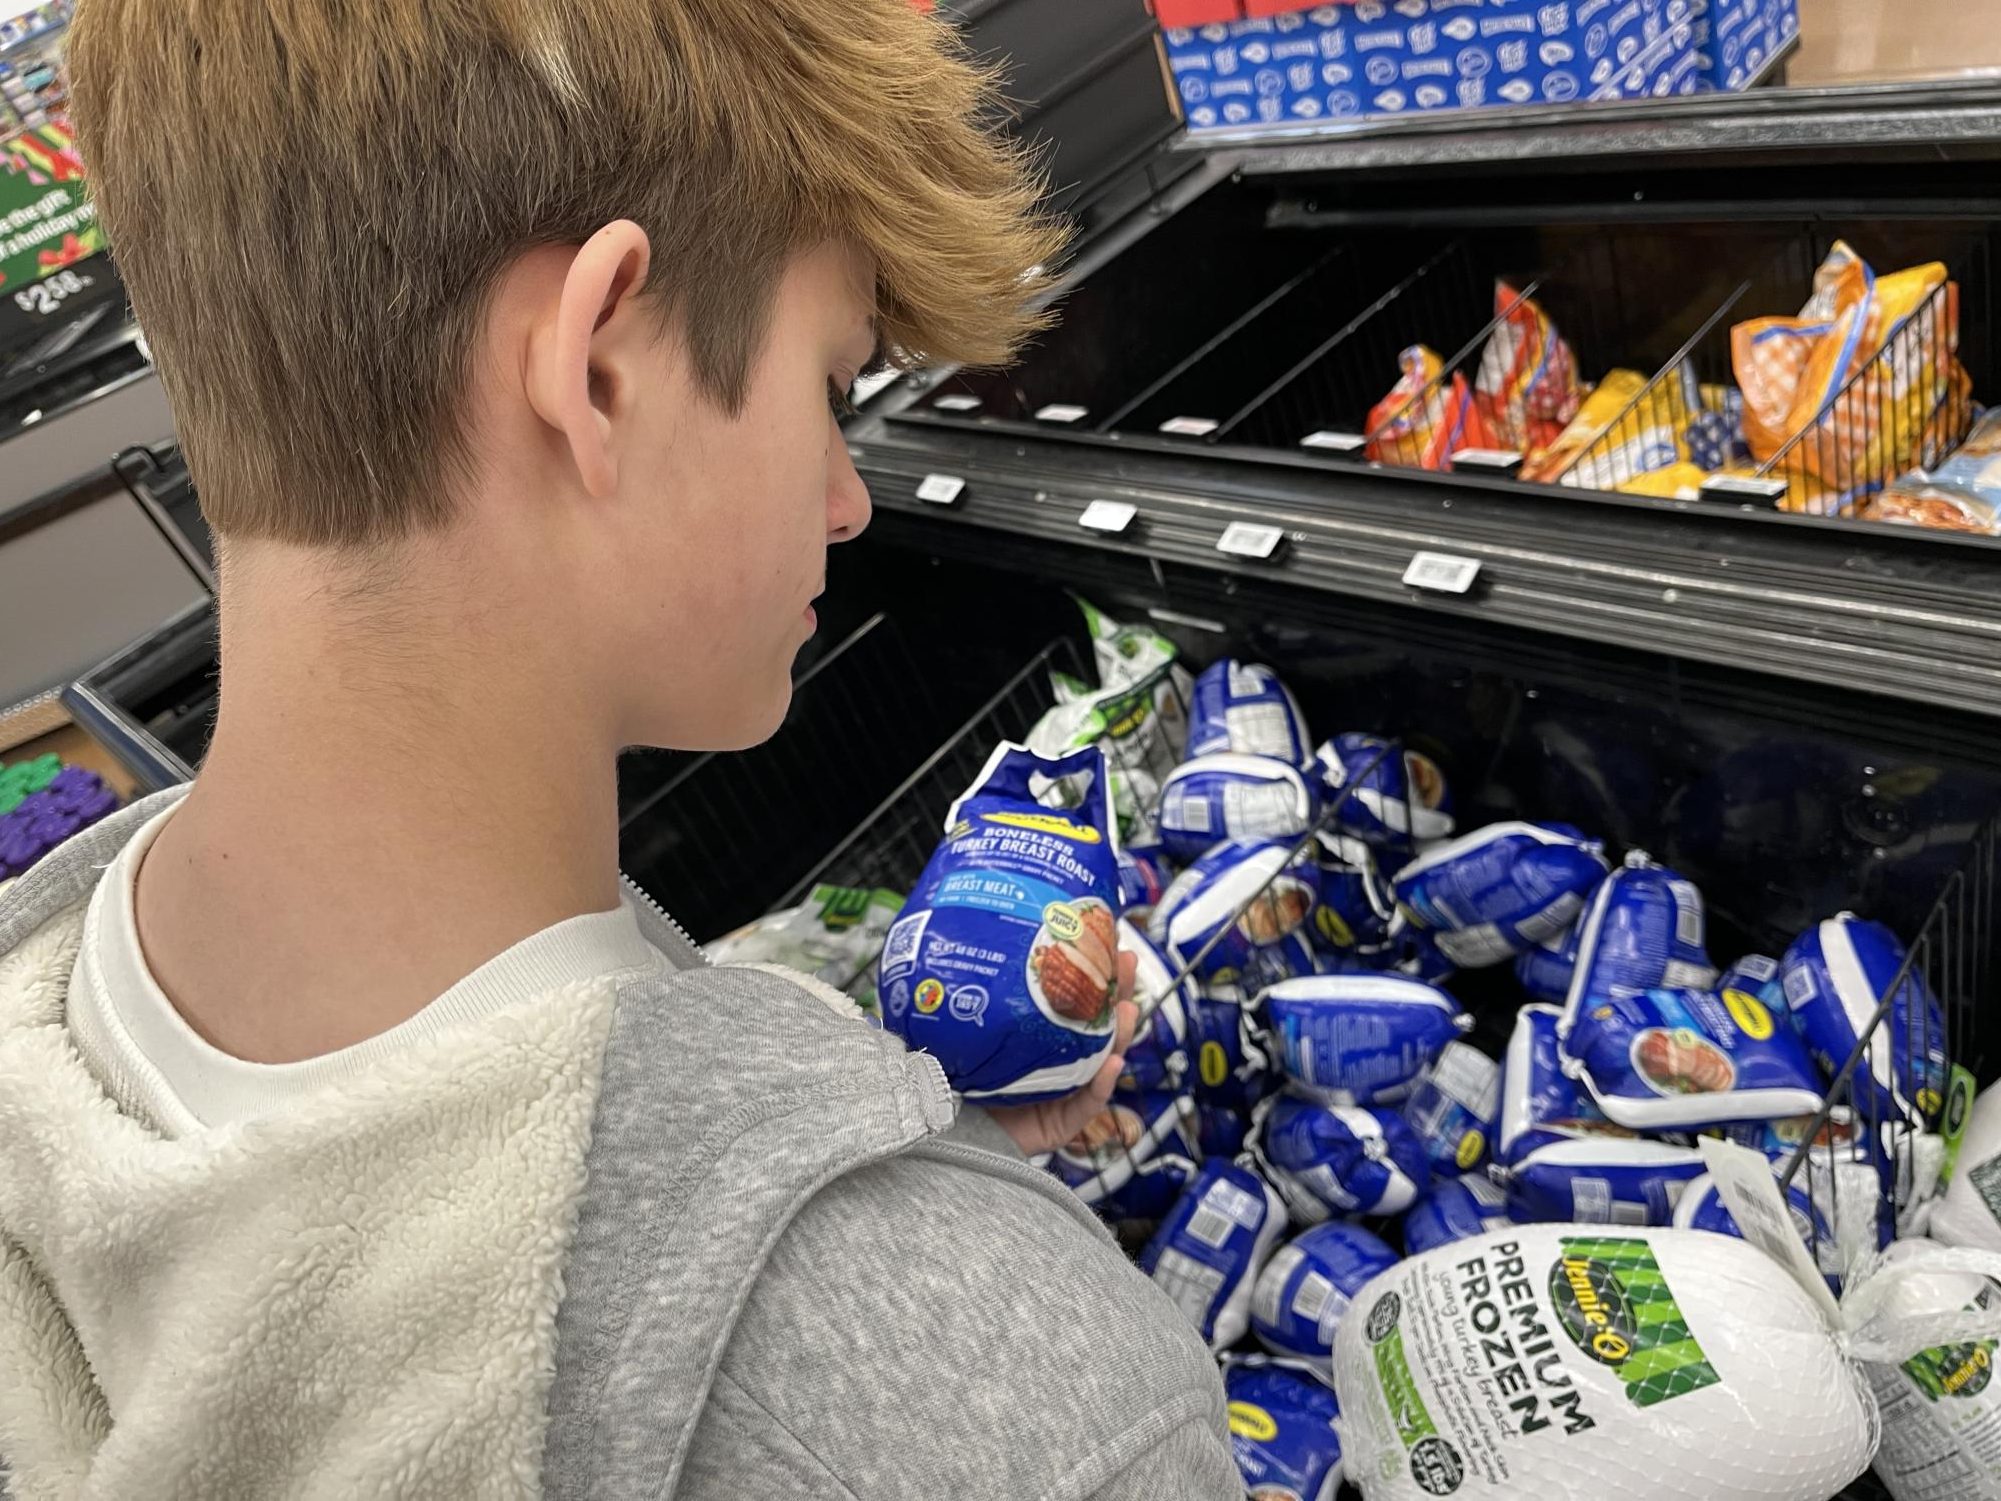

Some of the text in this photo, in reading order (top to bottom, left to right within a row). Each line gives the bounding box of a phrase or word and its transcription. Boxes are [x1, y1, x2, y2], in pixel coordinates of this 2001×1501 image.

[7, 205, 41, 229] the
[14, 212, 80, 252] holiday
[983, 826, 1075, 857] BONELESS
[951, 837, 998, 855] TURKEY
[1000, 838, 1058, 863] BREAST
[1057, 854, 1096, 888] ROAST
[943, 879, 1017, 897] BREAST MEAT
[1051, 914, 1078, 933] JUICY
[1431, 1271, 1459, 1317] young
[1452, 1317, 1482, 1377] turkey
[1476, 1378, 1519, 1439] breast
[1457, 1256, 1552, 1437] FROZEN
[1491, 1241, 1597, 1437] PREMIUM
